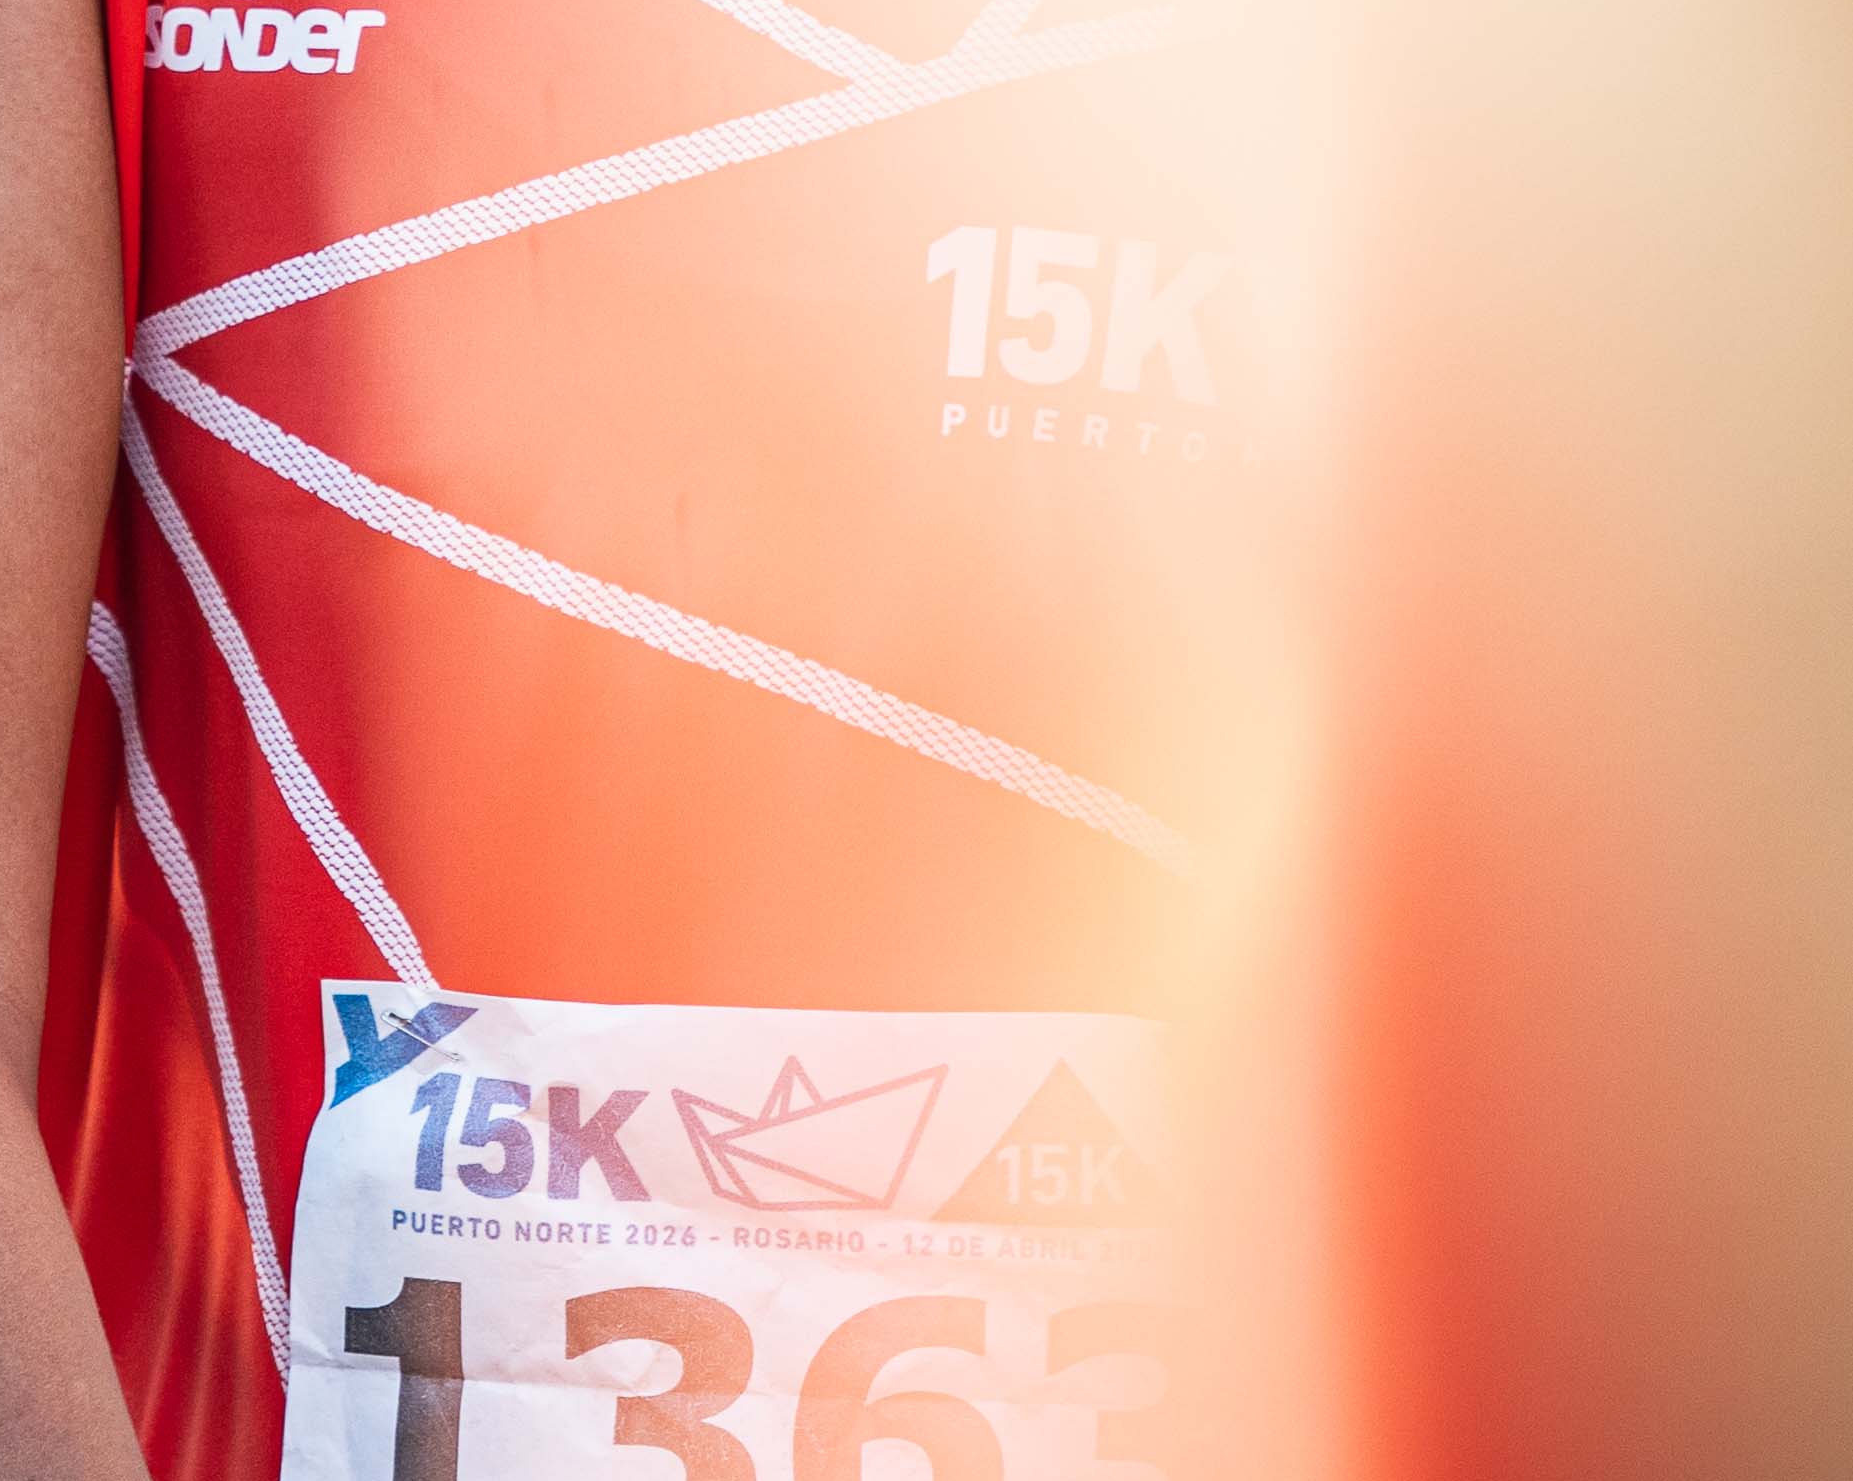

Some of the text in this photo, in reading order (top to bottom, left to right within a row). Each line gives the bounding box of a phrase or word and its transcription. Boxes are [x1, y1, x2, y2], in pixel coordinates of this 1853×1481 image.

[925, 224, 1237, 408] 15K
[941, 402, 1208, 463] PUERTO
[409, 1071, 652, 1202] 15K
[996, 1143, 1126, 1206] 15K
[391, 1208, 503, 1241] PUERTO
[514, 1219, 612, 1246] NORTE
[624, 1222, 698, 1248] 2026
[732, 1226, 867, 1254] ROSARIO
[902, 1232, 935, 1258] 12
[948, 1233, 986, 1259] DE
[997, 1235, 1091, 1262] ABRIL
